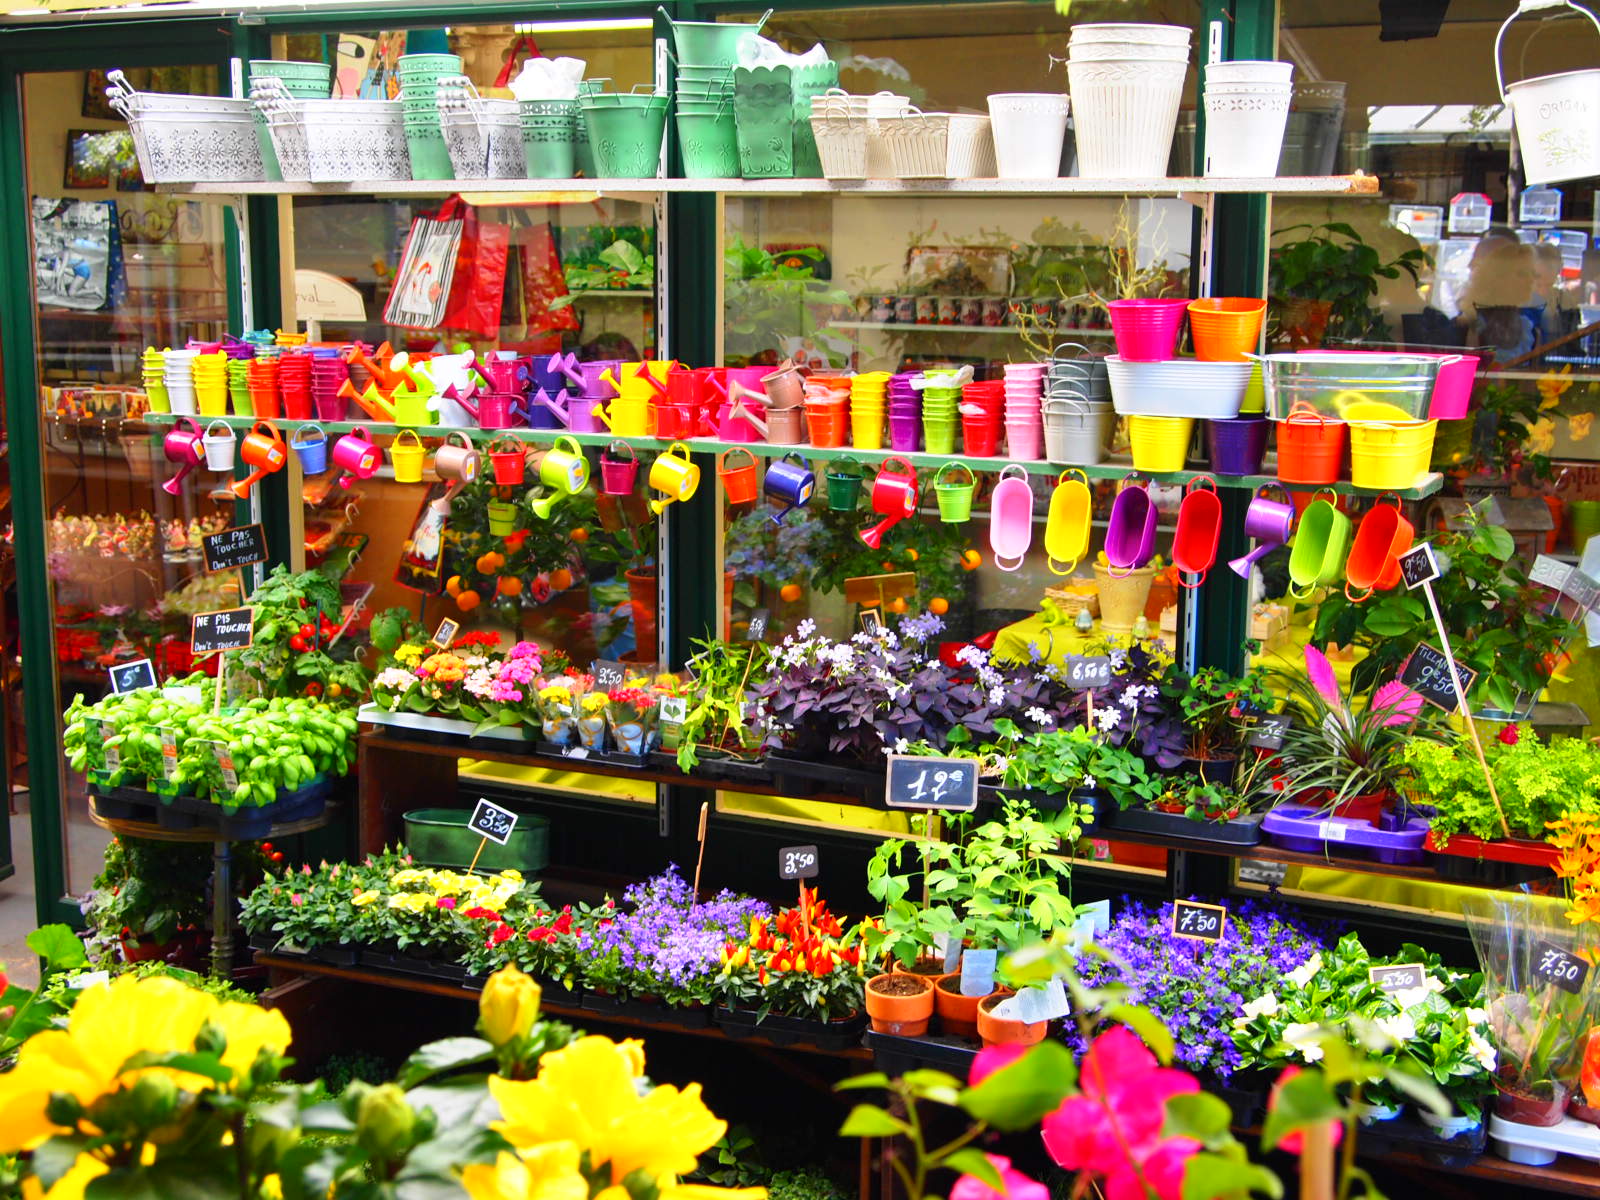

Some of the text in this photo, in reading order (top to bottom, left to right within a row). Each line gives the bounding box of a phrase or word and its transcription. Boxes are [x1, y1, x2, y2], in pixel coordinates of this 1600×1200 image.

[211, 530, 250, 546] NE PAS
[214, 537, 255, 556] TOUCHER
[196, 616, 210, 628] NE
[216, 623, 252, 635] TOUCHER
